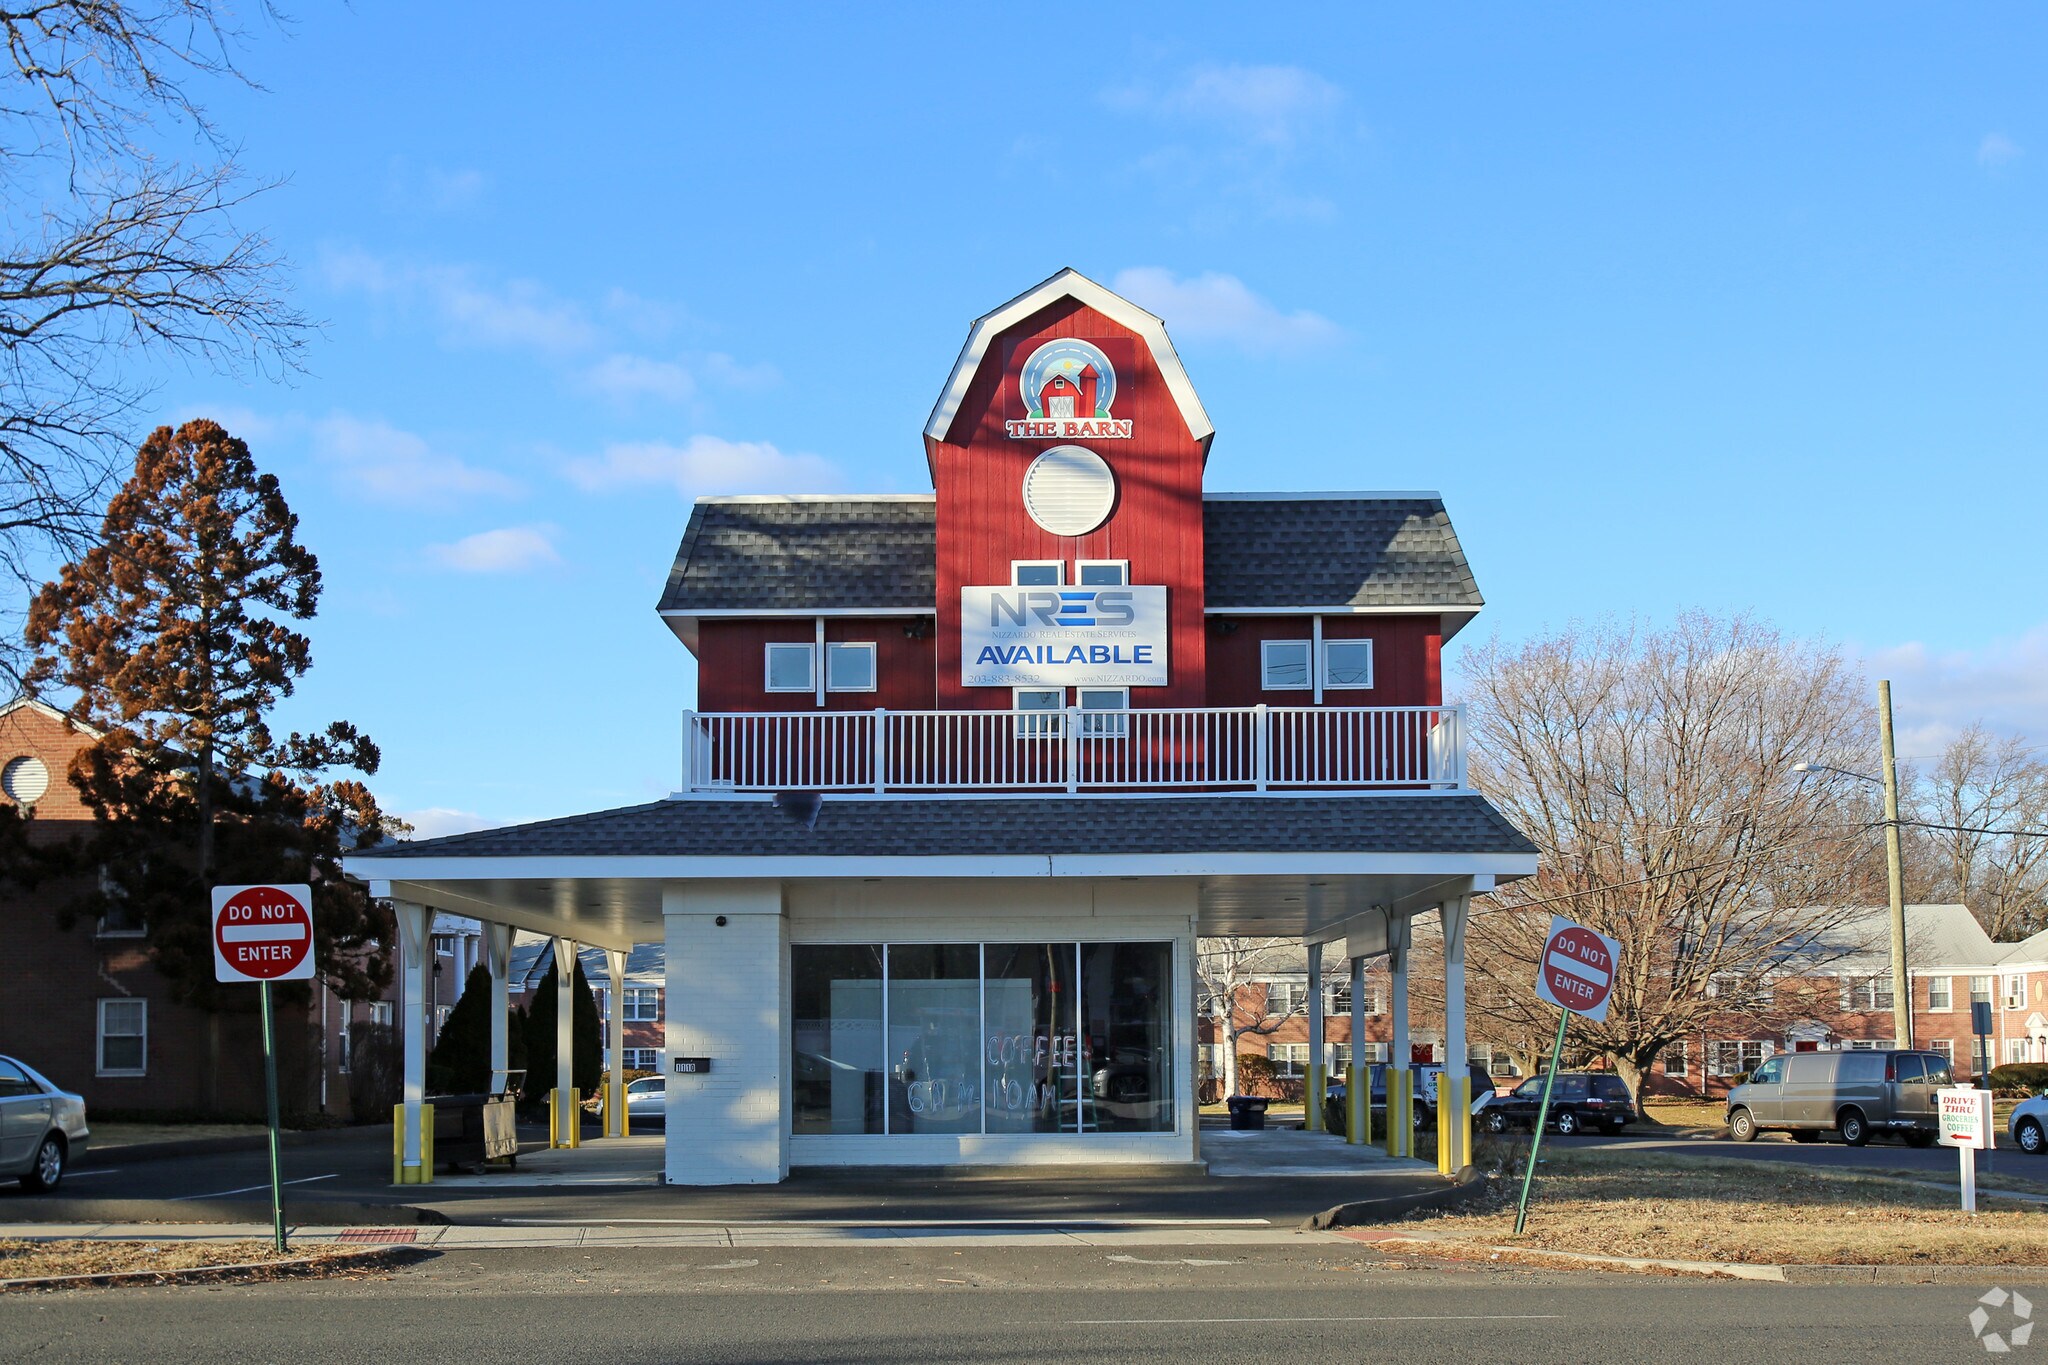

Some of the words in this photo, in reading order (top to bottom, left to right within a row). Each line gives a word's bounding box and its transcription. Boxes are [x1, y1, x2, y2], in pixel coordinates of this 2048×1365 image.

[1008, 421, 1057, 436] THE
[1064, 421, 1131, 436] BARN
[990, 591, 1135, 627] NRES
[992, 631, 1036, 639] NIZZARDO
[1039, 630, 1062, 638] REAL
[1064, 630, 1096, 638] ESTATE
[1097, 629, 1137, 638] SERVICES
[976, 645, 1153, 665] AVAILABLE
[968, 674, 1040, 684] 203-883-8532
[1074, 674, 1165, 683] www.NIZZARDO.com
[229, 905, 252, 920] DO
[261, 904, 295, 919] NOT
[238, 945, 292, 961] ENTER
[1558, 936, 1576, 953] DO
[1580, 946, 1606, 965] NOT
[1554, 974, 1593, 999] ENTER
[987, 1035, 1076, 1067] COFFEE
[1943, 1096, 1976, 1105] DRIVE
[1944, 1105, 1974, 1113] THRU
[1942, 1114, 1978, 1123] GROCERIES
[1947, 1123, 1973, 1132] COFFEE
